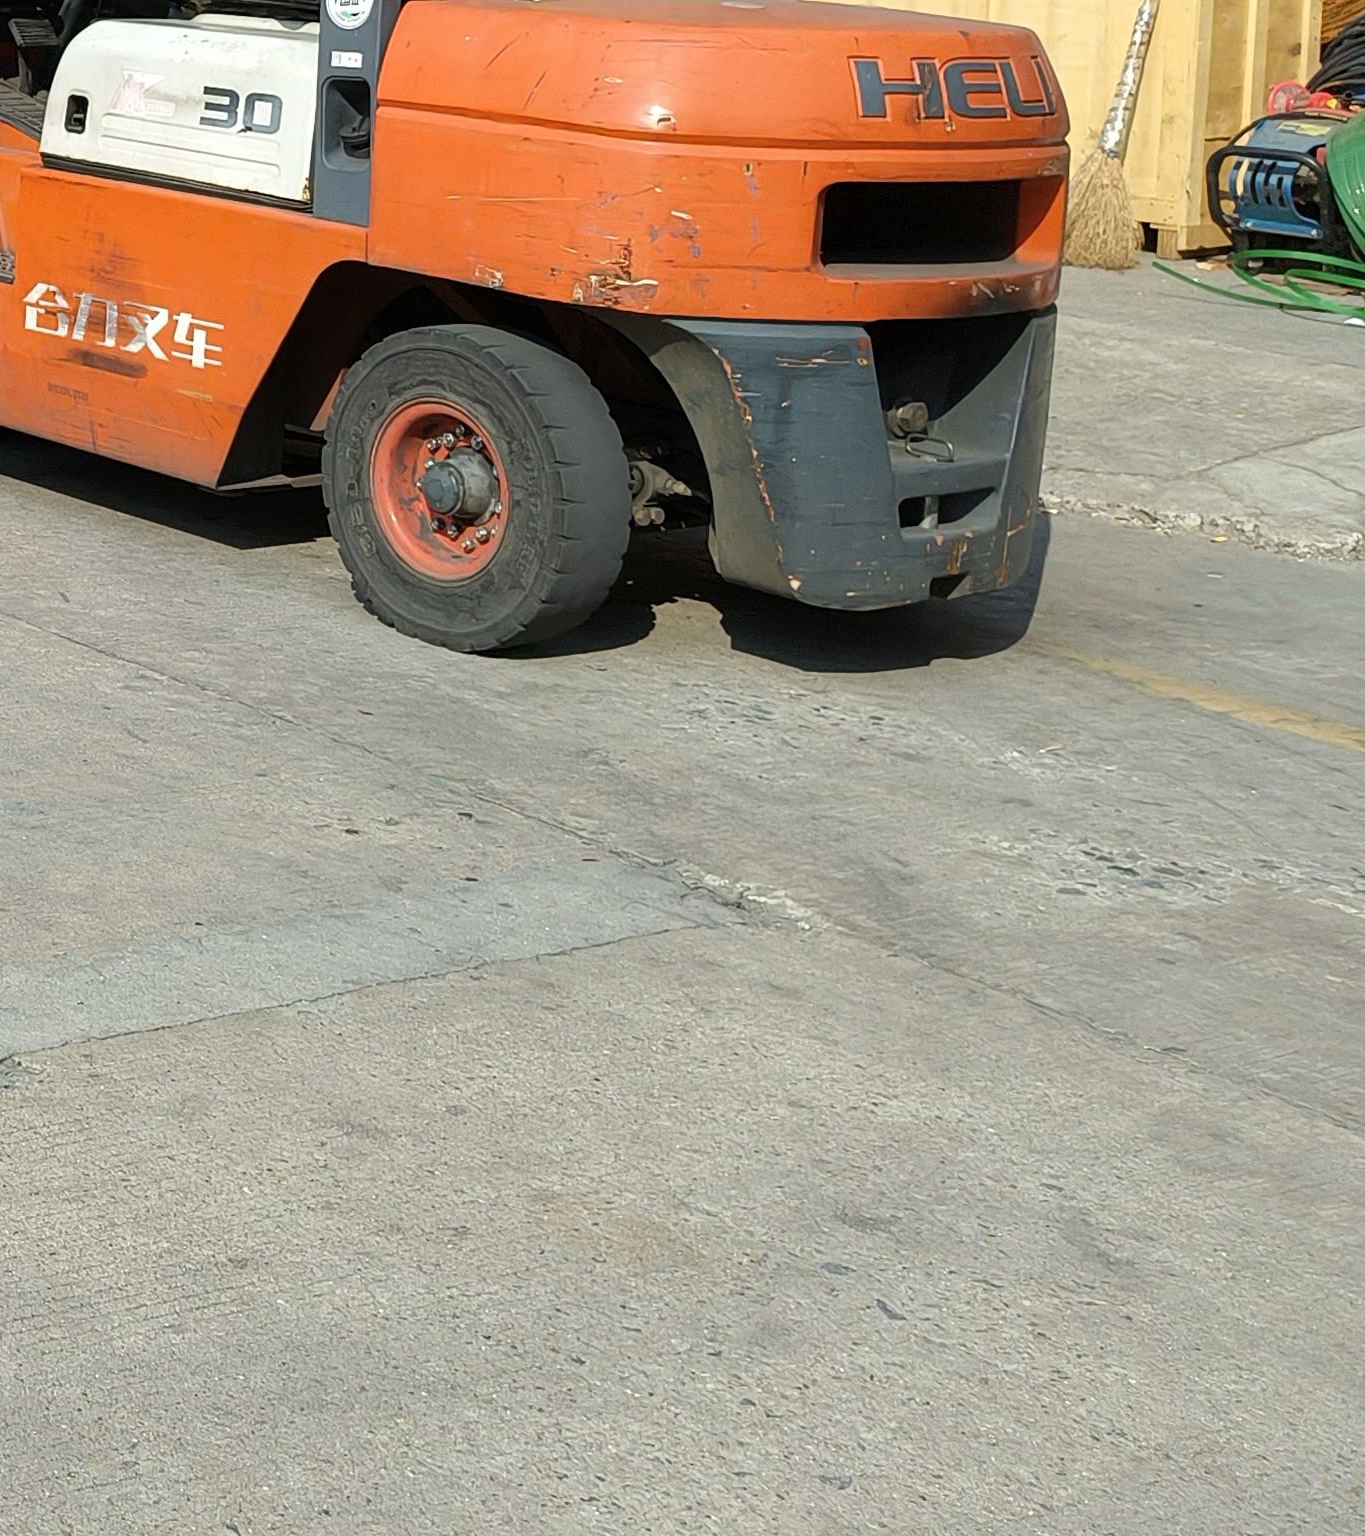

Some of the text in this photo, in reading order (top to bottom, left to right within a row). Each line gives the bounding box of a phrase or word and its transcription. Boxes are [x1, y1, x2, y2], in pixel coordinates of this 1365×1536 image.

[199, 85, 284, 135] 30
[851, 58, 1056, 120] HELI
[22, 282, 225, 369] 合力叉车
